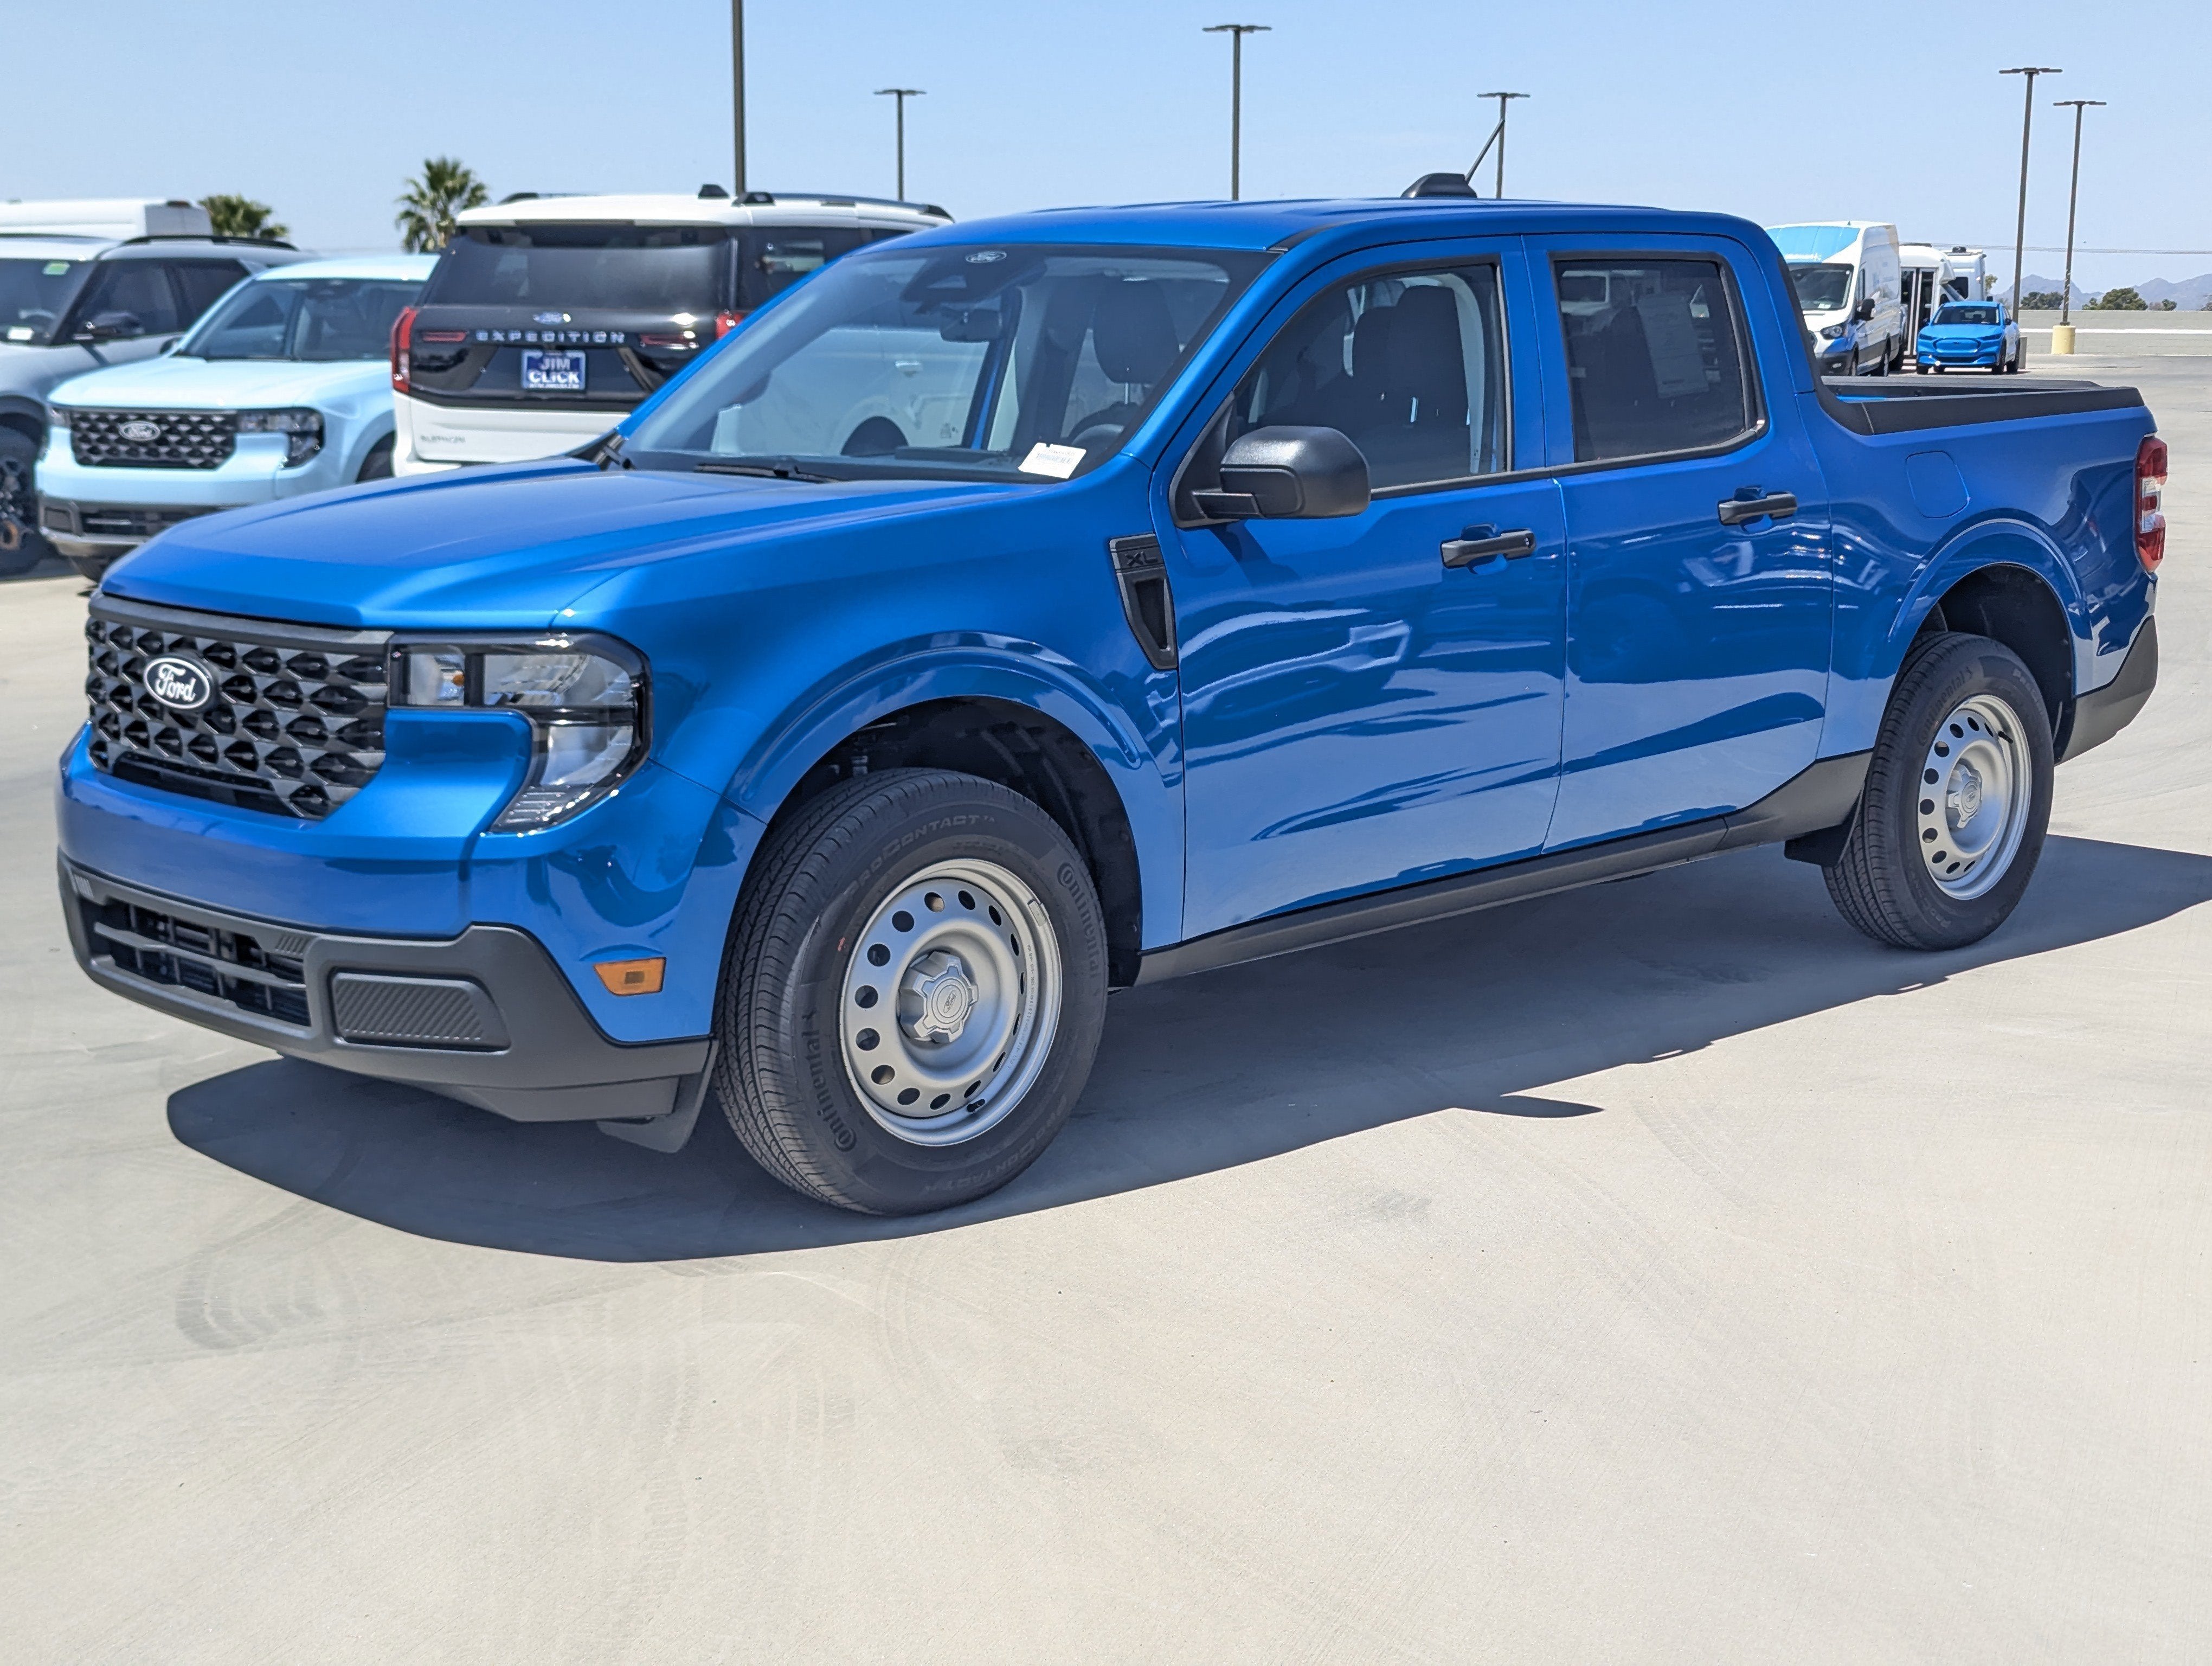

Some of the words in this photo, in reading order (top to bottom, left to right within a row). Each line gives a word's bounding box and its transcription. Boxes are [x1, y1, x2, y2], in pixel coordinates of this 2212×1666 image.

[475, 330, 625, 343] EXPEDITION
[539, 358, 570, 370] JIM
[528, 370, 580, 383] CLICK
[1126, 551, 1158, 566] XL
[155, 663, 196, 702] Ford
[1058, 862, 1099, 978] Continental
[802, 1030, 857, 1152] Continental
